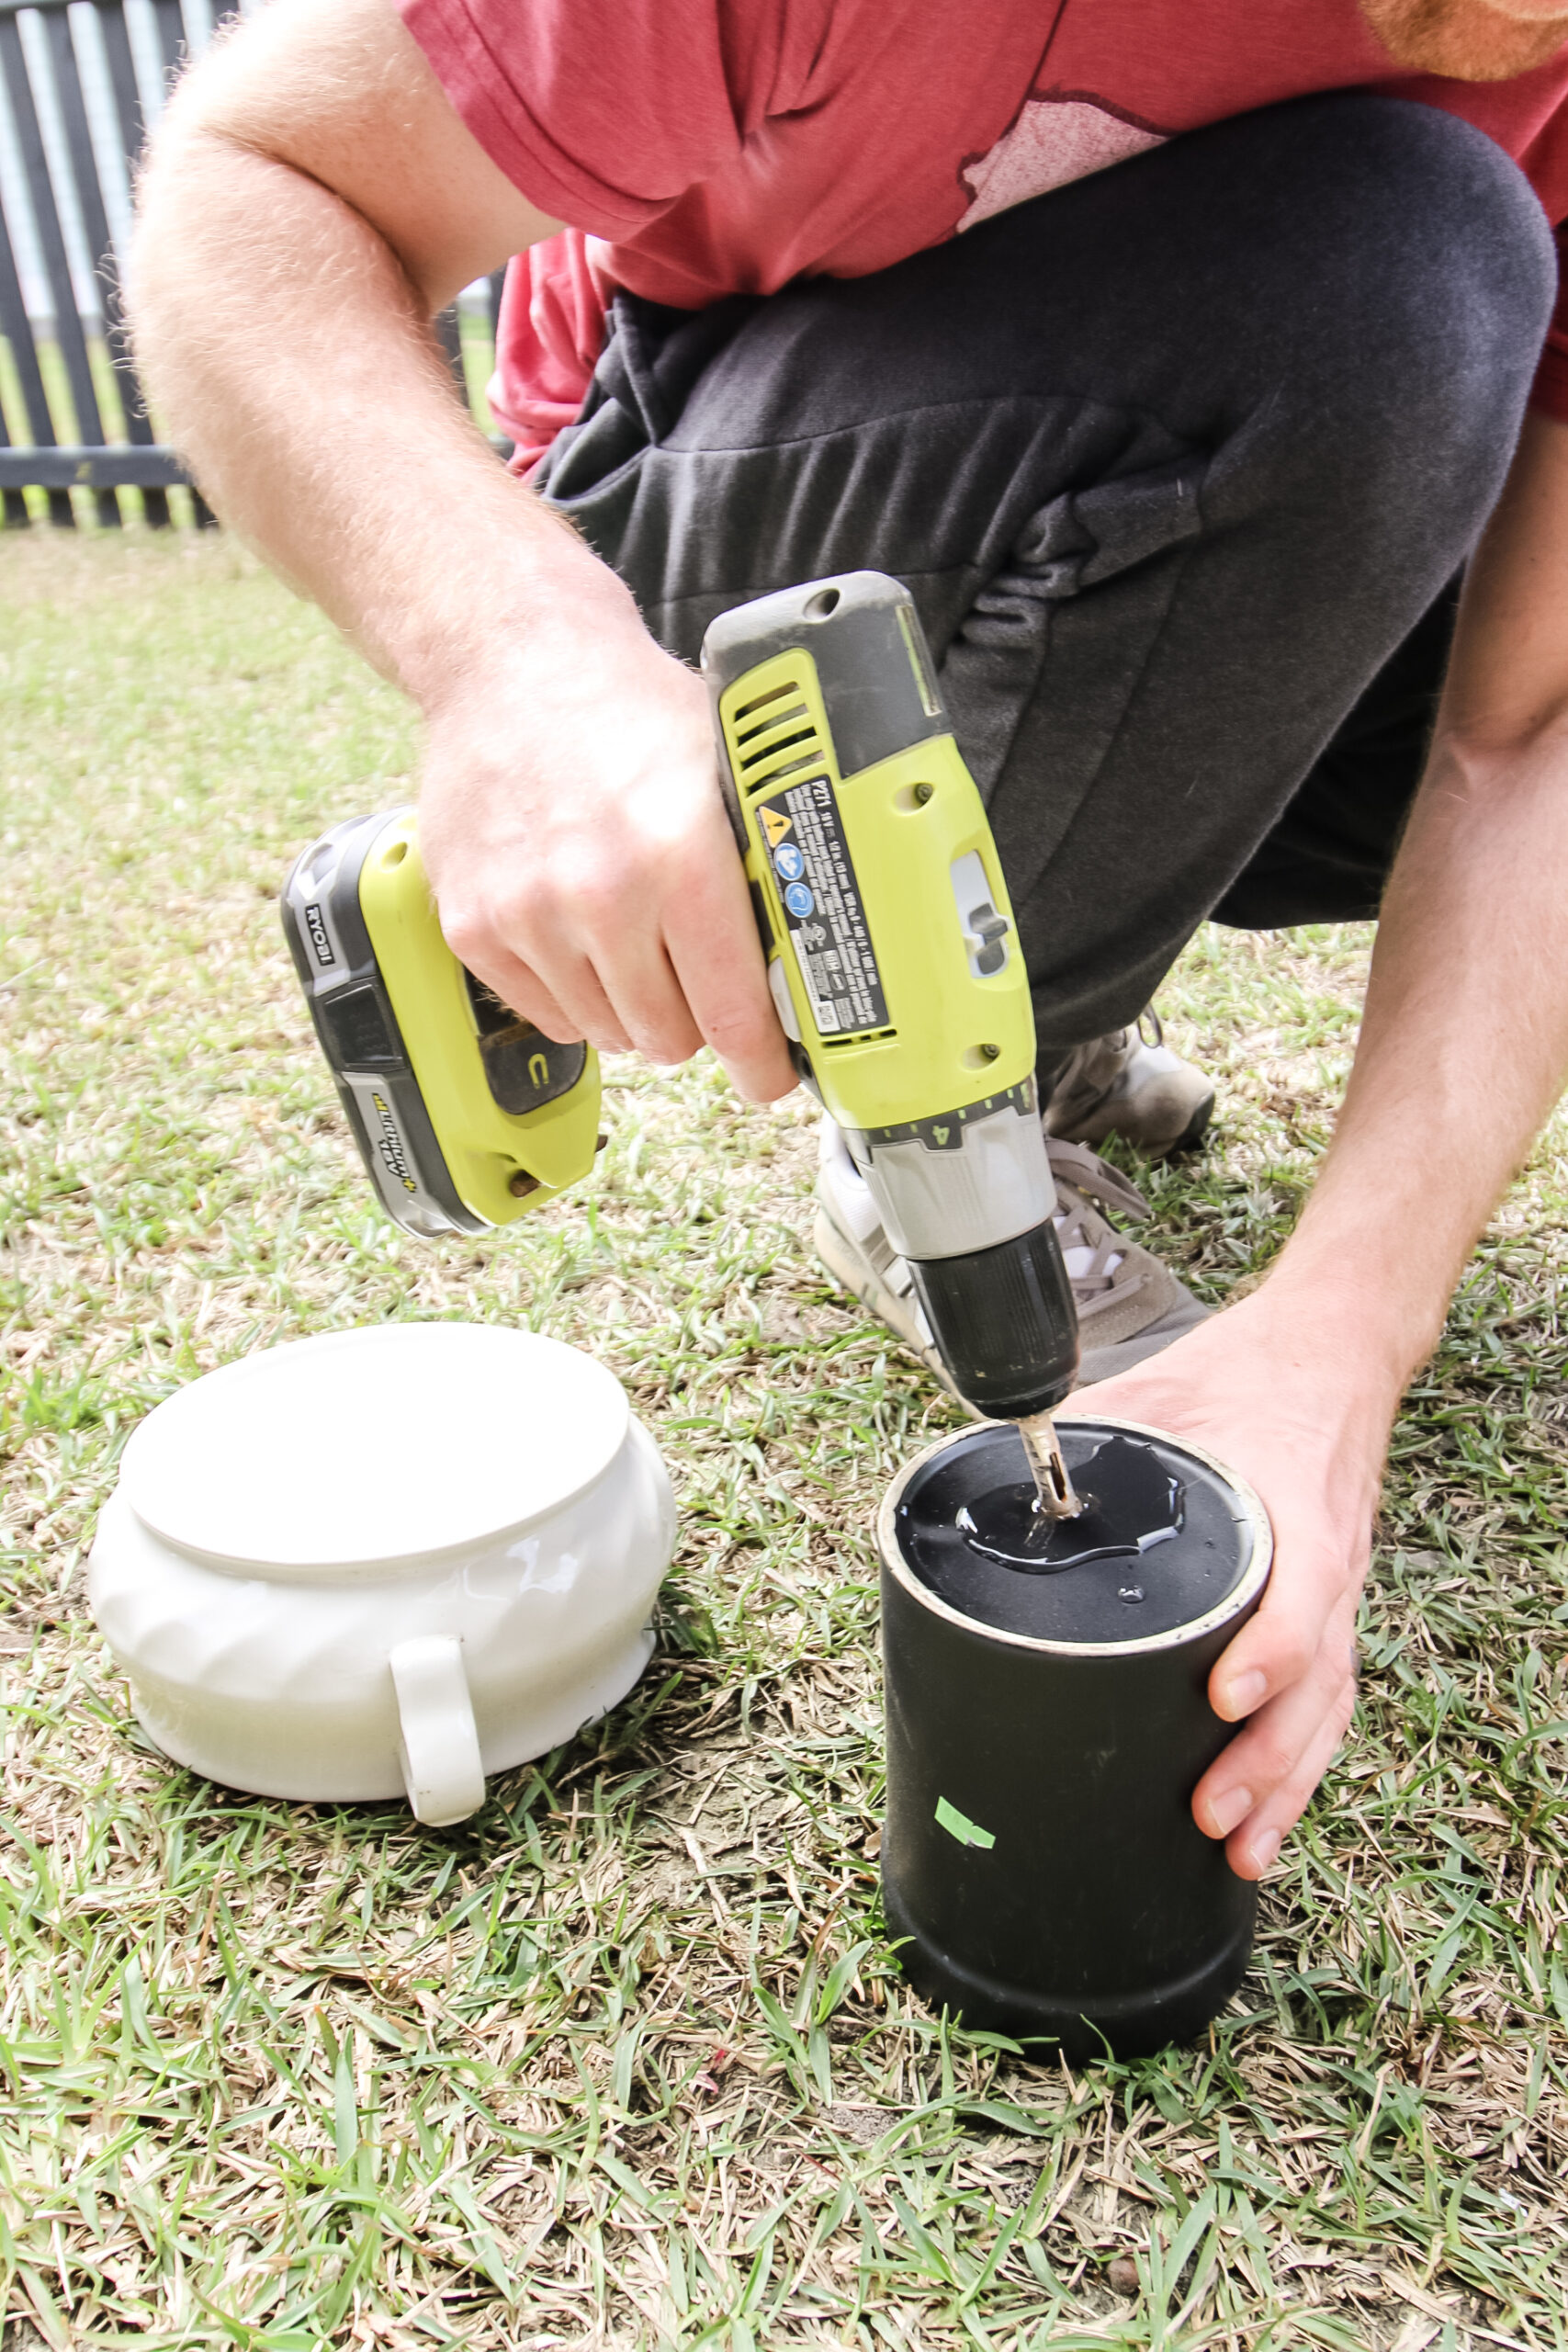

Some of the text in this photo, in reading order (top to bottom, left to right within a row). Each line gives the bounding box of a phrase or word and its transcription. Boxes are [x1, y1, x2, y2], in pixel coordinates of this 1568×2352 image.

[812, 780, 831, 806] P271
[307, 907, 332, 962] RYOBI
[933, 1125, 950, 1146] 4
